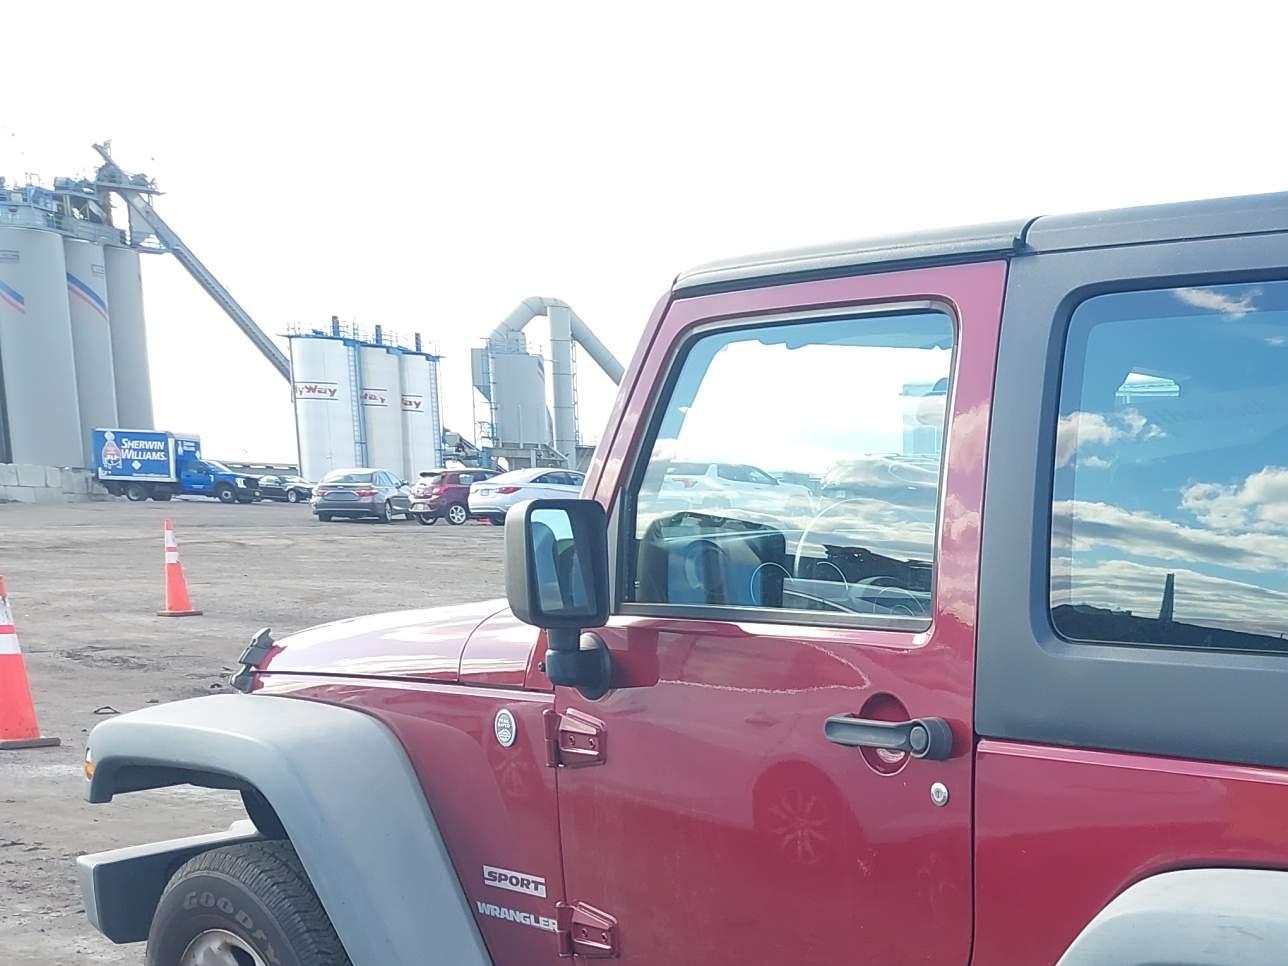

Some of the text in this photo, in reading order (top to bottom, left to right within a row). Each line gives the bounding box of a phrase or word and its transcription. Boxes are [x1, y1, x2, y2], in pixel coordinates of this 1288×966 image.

[120, 438, 165, 450] SHERWIN
[486, 870, 545, 891] SPORT
[475, 900, 558, 931] WRANGLER
